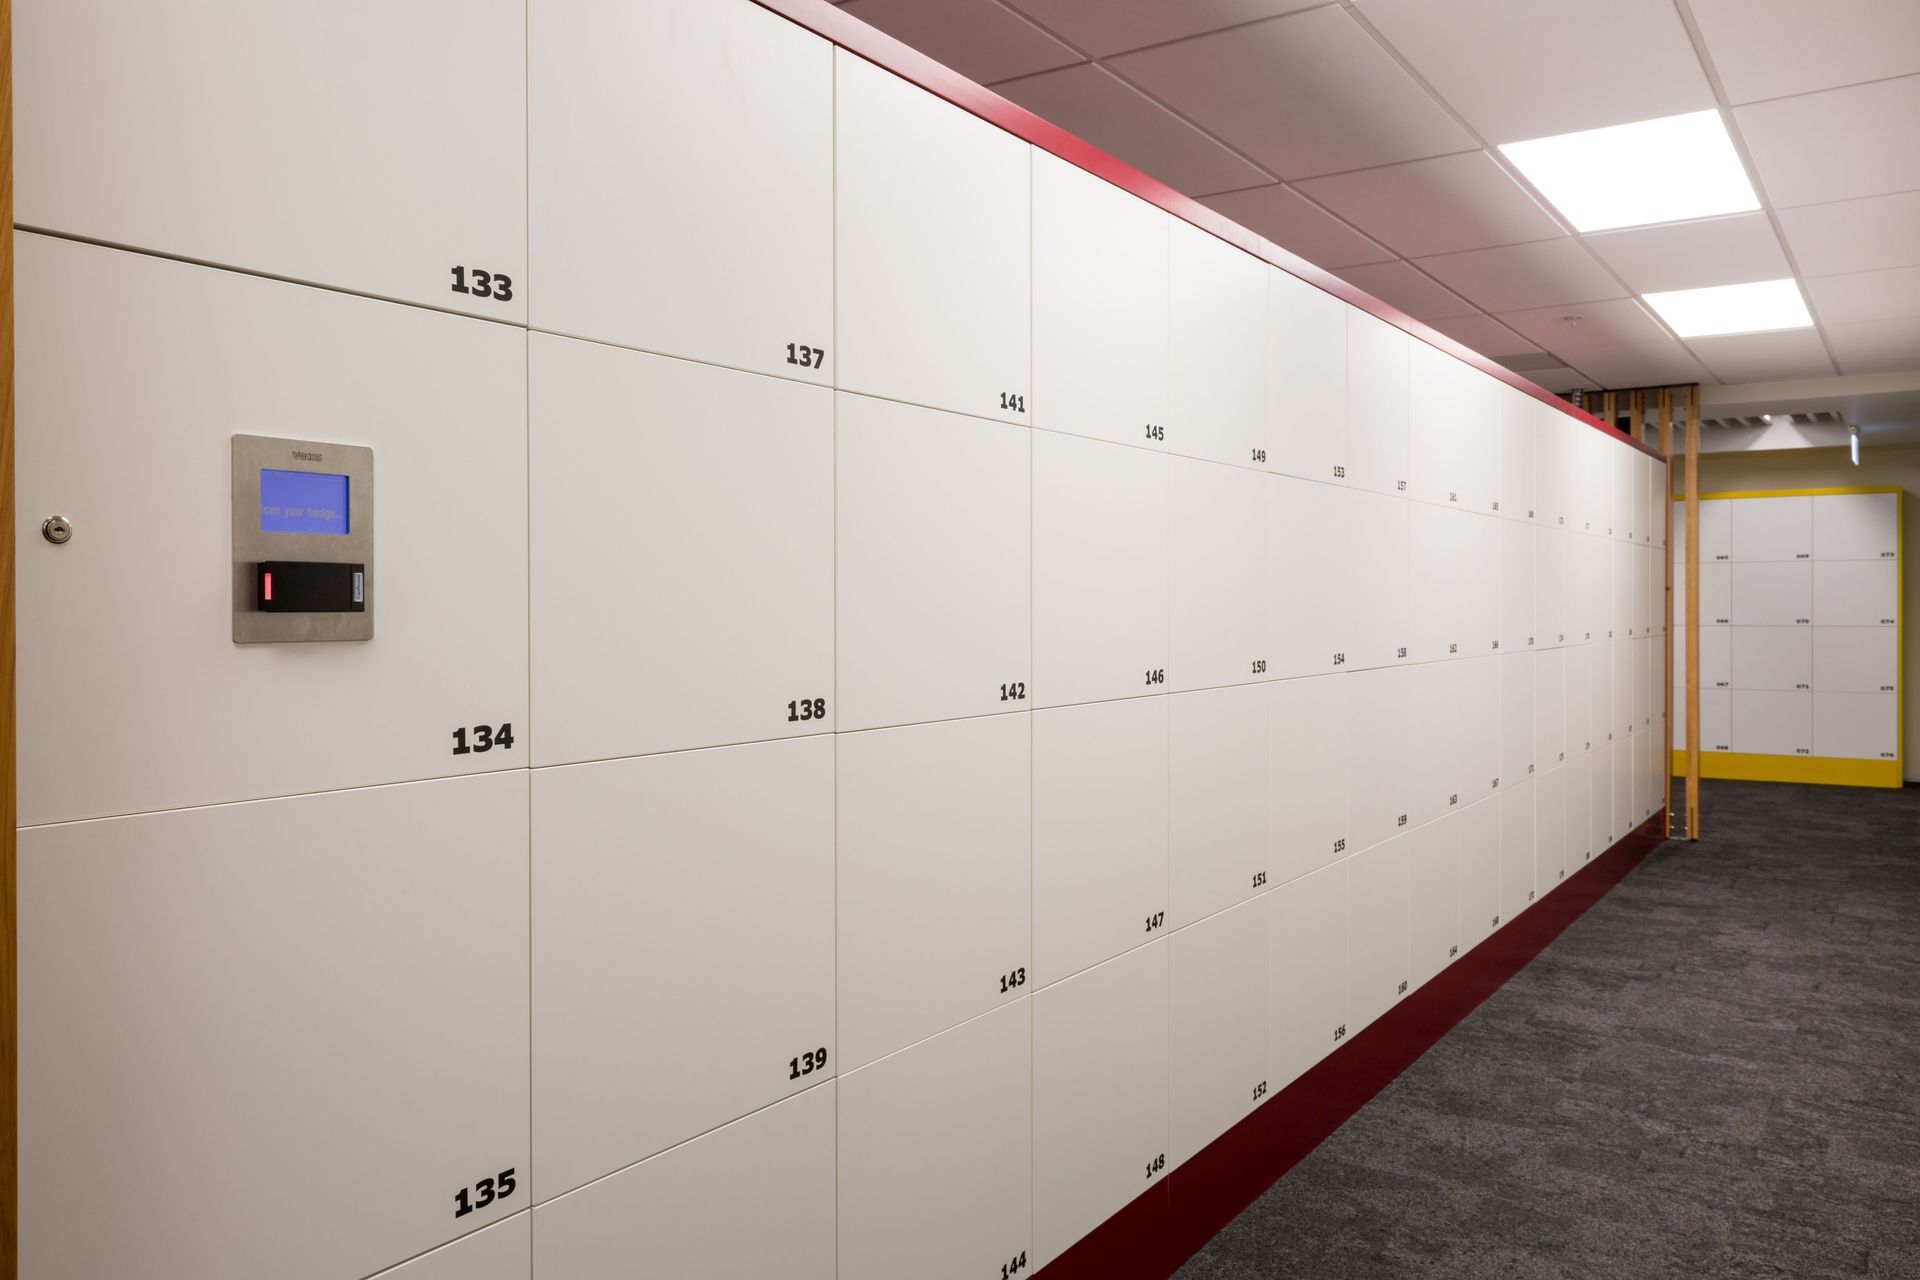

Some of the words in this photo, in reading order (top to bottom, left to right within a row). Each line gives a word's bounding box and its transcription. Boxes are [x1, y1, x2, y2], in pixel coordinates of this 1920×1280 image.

[451, 266, 512, 301] 133
[787, 343, 824, 369] 137
[1001, 392, 1025, 413] 141
[1146, 424, 1164, 441] 145
[1252, 447, 1267, 463] 149
[1333, 465, 1345, 479] 153
[1397, 480, 1407, 491] 157
[283, 507, 303, 518] your
[1333, 652, 1345, 666] 154
[1397, 647, 1407, 659] 158
[1251, 659, 1267, 674] 150
[1146, 669, 1164, 685] 146
[1001, 682, 1025, 701] 142
[788, 698, 825, 722] 138
[453, 723, 514, 755] 134
[1397, 813, 1408, 828] 159
[1333, 838, 1346, 854] 155
[1252, 871, 1267, 889] 151
[1146, 912, 1164, 932] 147
[1001, 968, 1025, 993] 143
[1334, 1023, 1346, 1042] 156
[790, 1047, 827, 1080] 139
[1252, 1080, 1268, 1102] 152
[1146, 1154, 1165, 1179] 148
[455, 1168, 516, 1218] 135
[1001, 1250, 1026, 1280] 144
